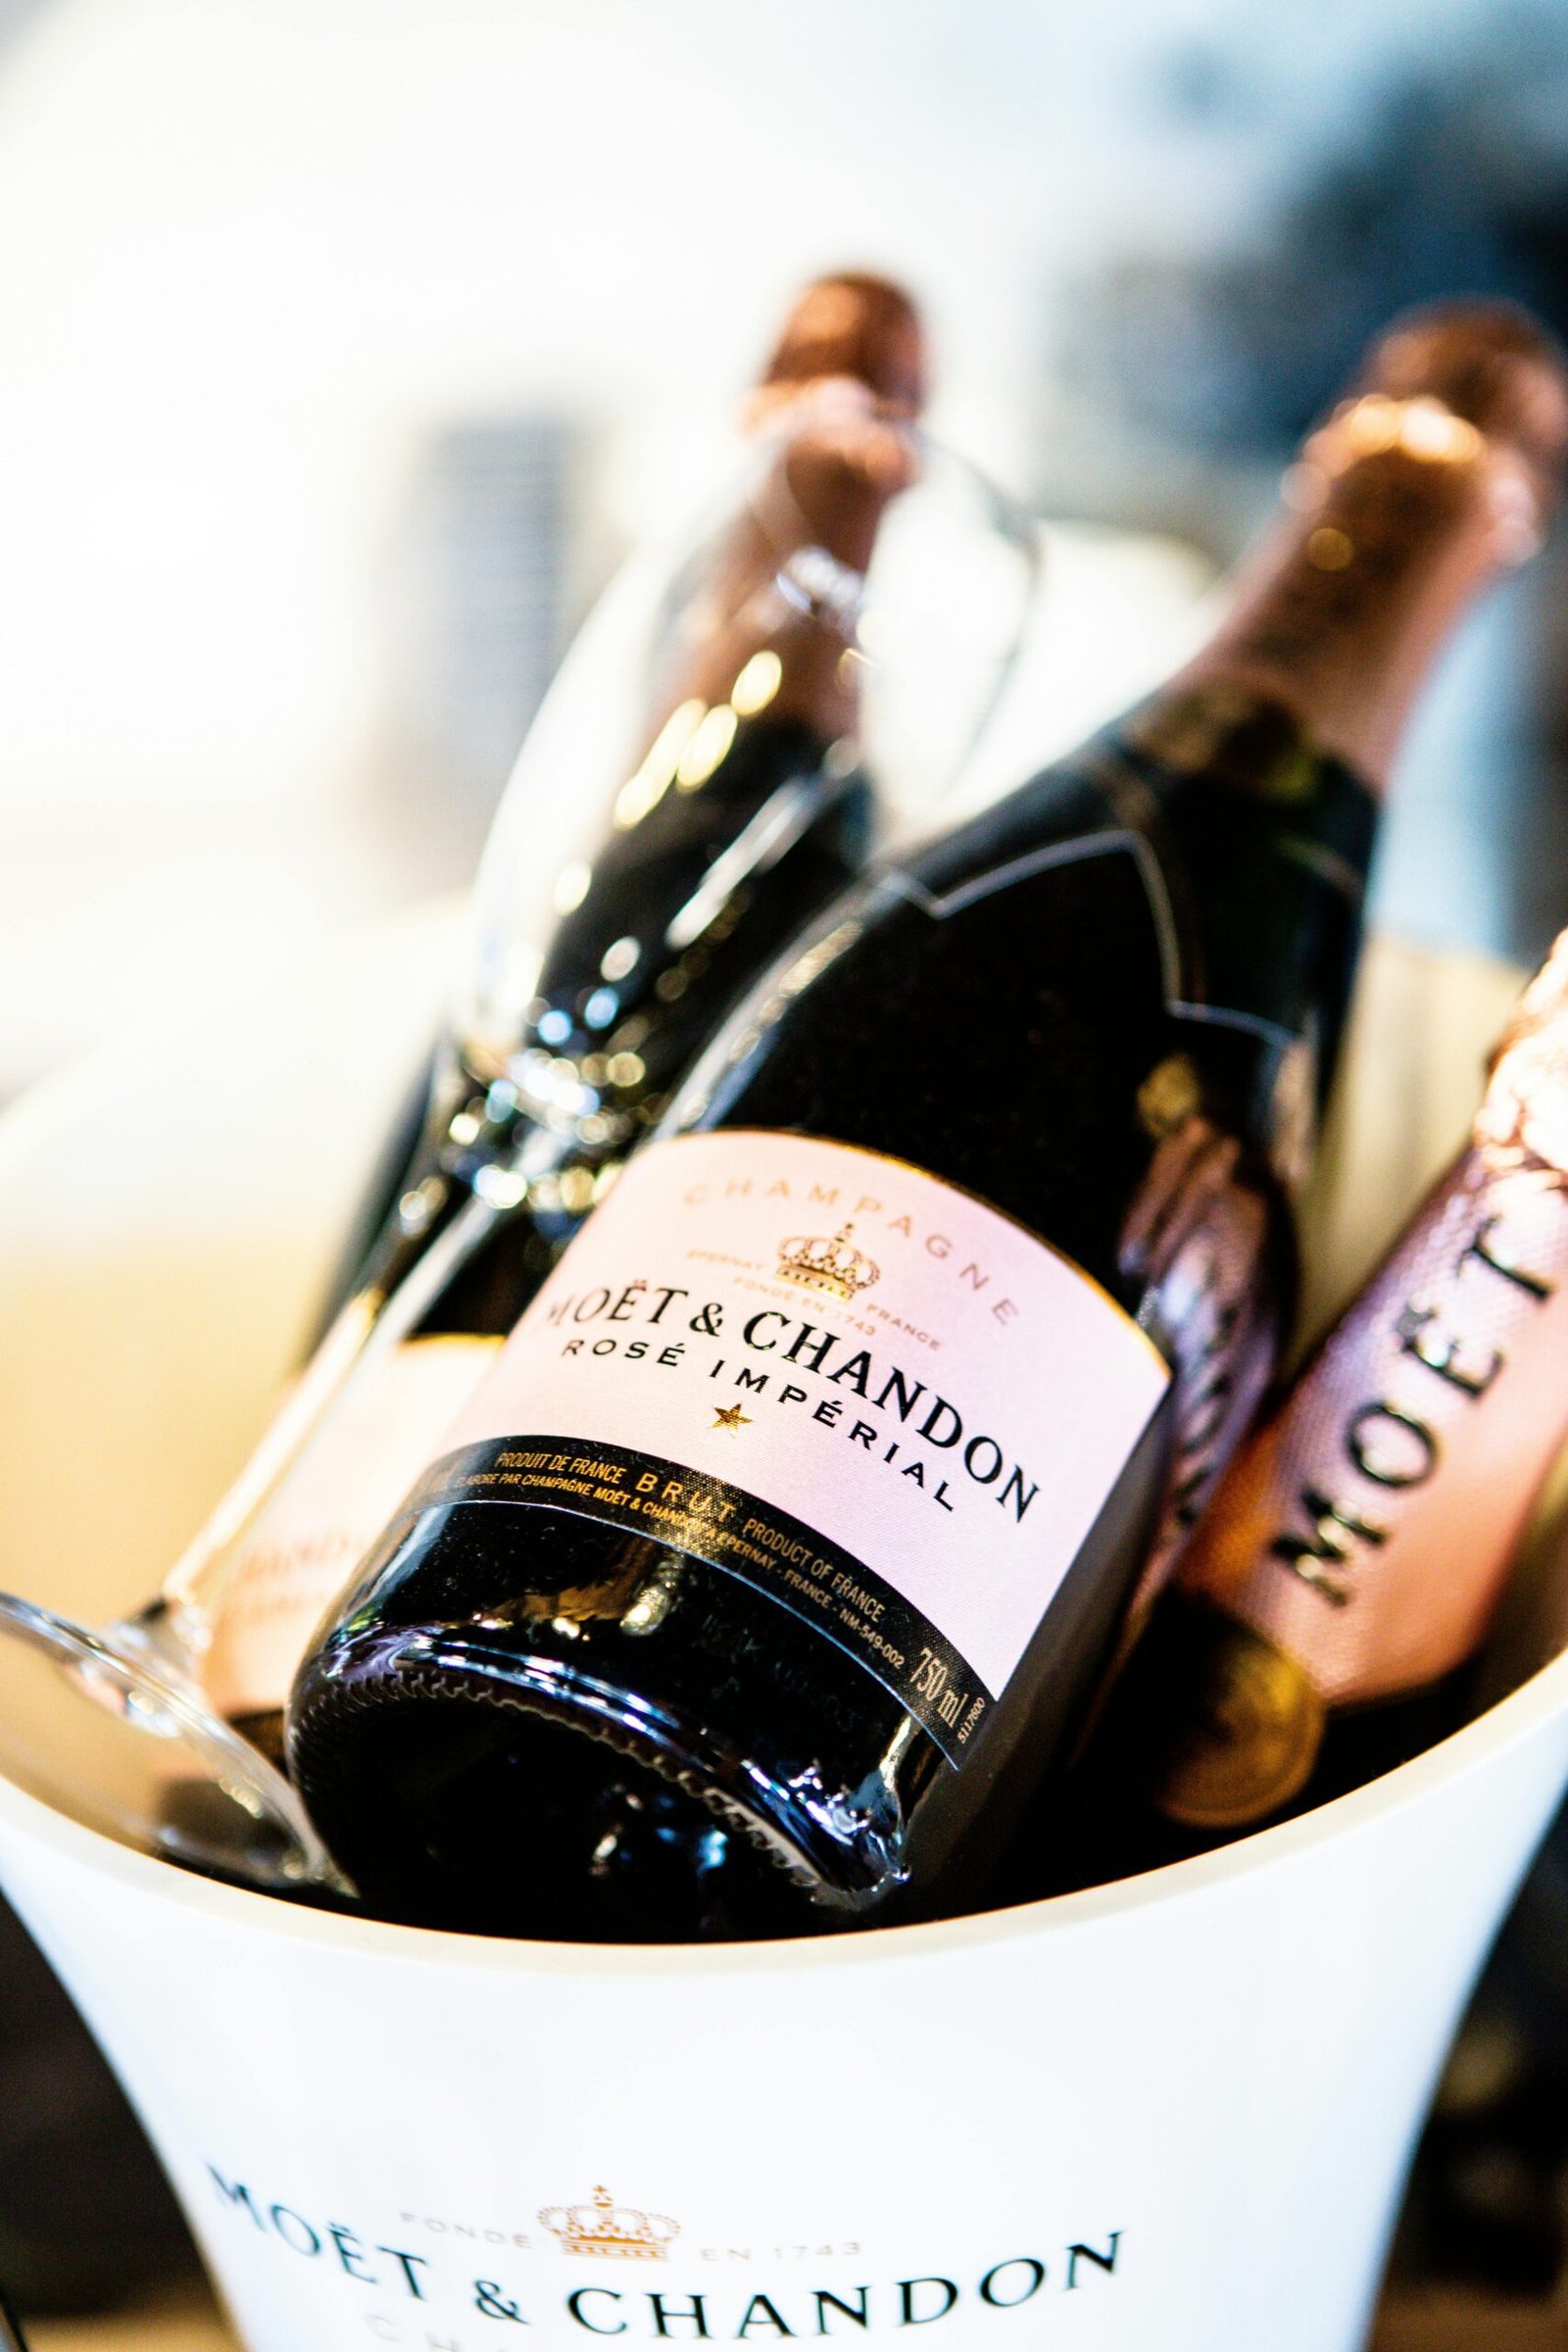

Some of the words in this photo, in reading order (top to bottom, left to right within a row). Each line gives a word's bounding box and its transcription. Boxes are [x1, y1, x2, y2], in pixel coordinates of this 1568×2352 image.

[683, 1178, 1019, 1327] CHAMPAGNE
[865, 1303, 942, 1351] FRANCE
[561, 1339, 686, 1368] ROSÉ
[708, 1358, 955, 1513] IMPÉRIAL
[688, 1301, 723, 1338] &
[742, 1310, 1042, 1524] CHANDON
[494, 1452, 553, 1469] PRODUIT
[547, 1454, 571, 1472] DE
[567, 1457, 627, 1485] FRANCE
[635, 1472, 737, 1523] BRUT
[741, 1518, 814, 1568] PRODUCT
[809, 1558, 834, 1581] OF
[830, 1572, 886, 1623] FRANCE
[498, 1473, 520, 1486] PAR
[520, 1474, 595, 1497] CHAMPAGNE
[628, 1496, 642, 1510] &
[784, 1569, 833, 1610] FRANCE
[839, 1608, 906, 1670] NM-549-002
[909, 1646, 949, 1701] 750
[937, 1689, 969, 1729] ml
[204, 2162, 427, 2303] MOËT
[473, 2278, 532, 2326] &
[564, 2229, 1126, 2339] CHANDON
[700, 2247, 754, 2262] EN
[771, 2240, 862, 2259] 1743
